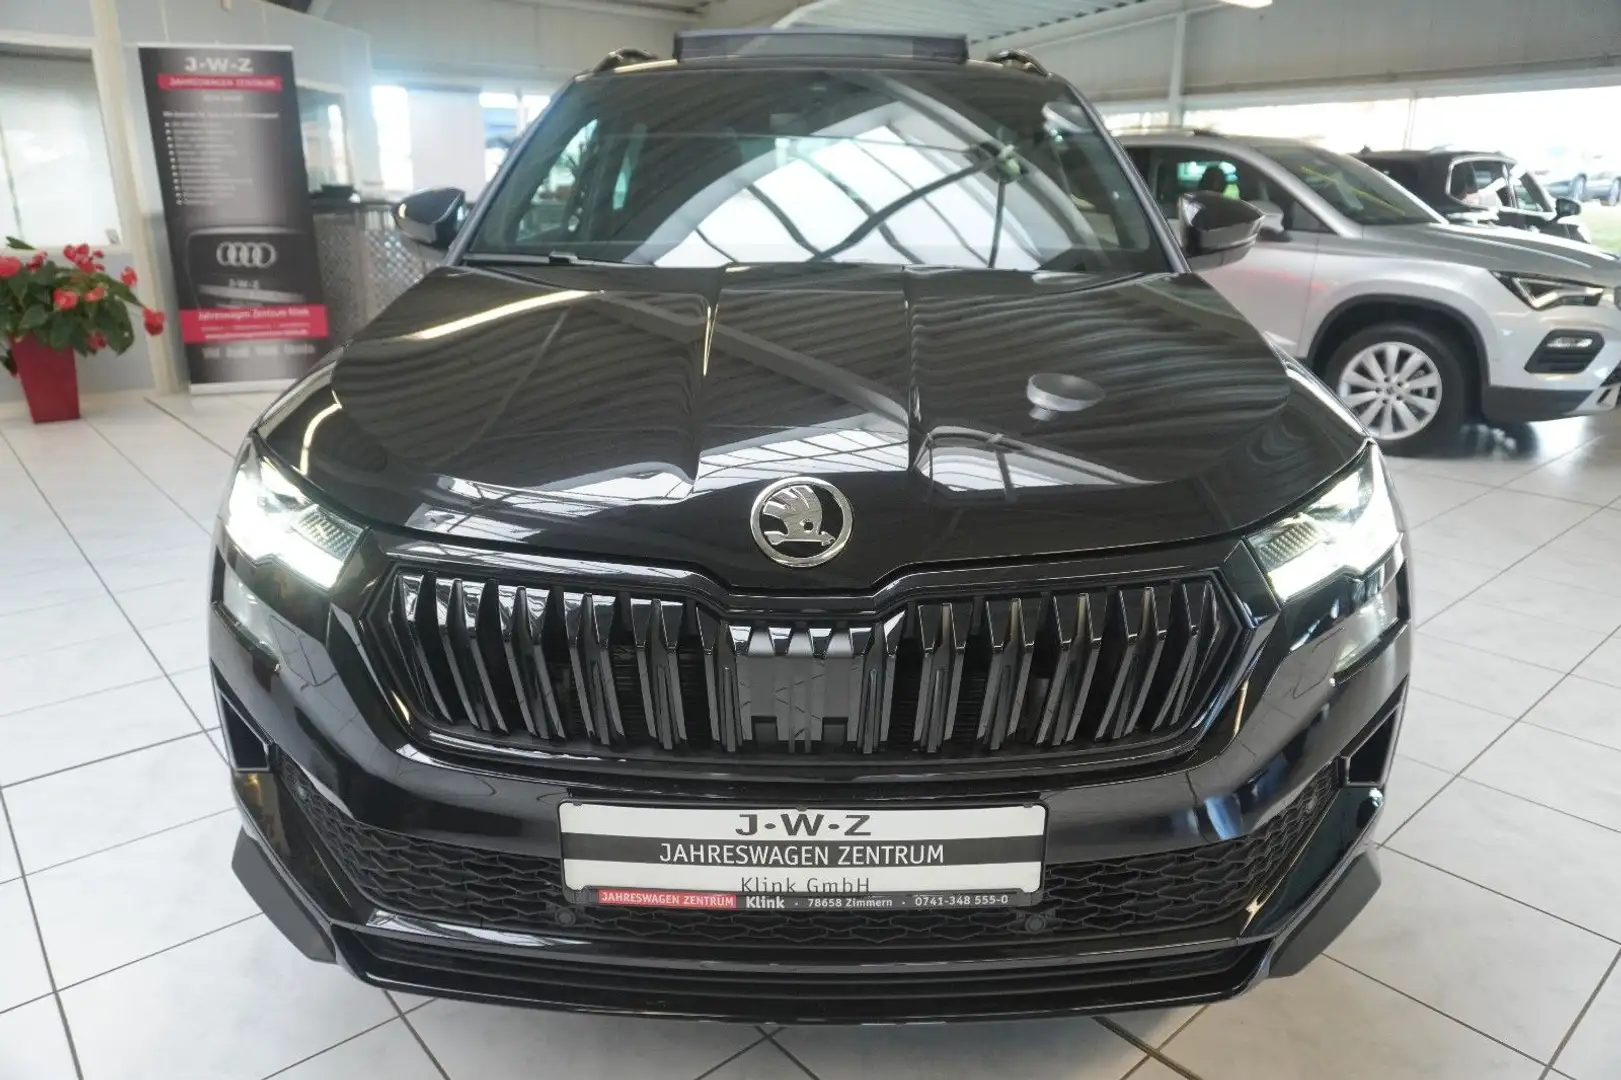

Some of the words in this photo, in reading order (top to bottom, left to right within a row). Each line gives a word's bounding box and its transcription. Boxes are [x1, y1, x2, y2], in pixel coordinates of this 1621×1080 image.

[659, 842, 829, 866] JAHRESWAGEN
[837, 844, 945, 866] ZENTRUM
[741, 876, 797, 893] Klink
[806, 877, 870, 893] GmbH
[601, 891, 680, 905] JAHRESWAGEN
[683, 894, 734, 908] ZENTRUM
[745, 895, 786, 909] Klink
[807, 897, 842, 908] 78658
[845, 897, 893, 908] Zimmern
[974, 894, 1009, 906] 555-0
